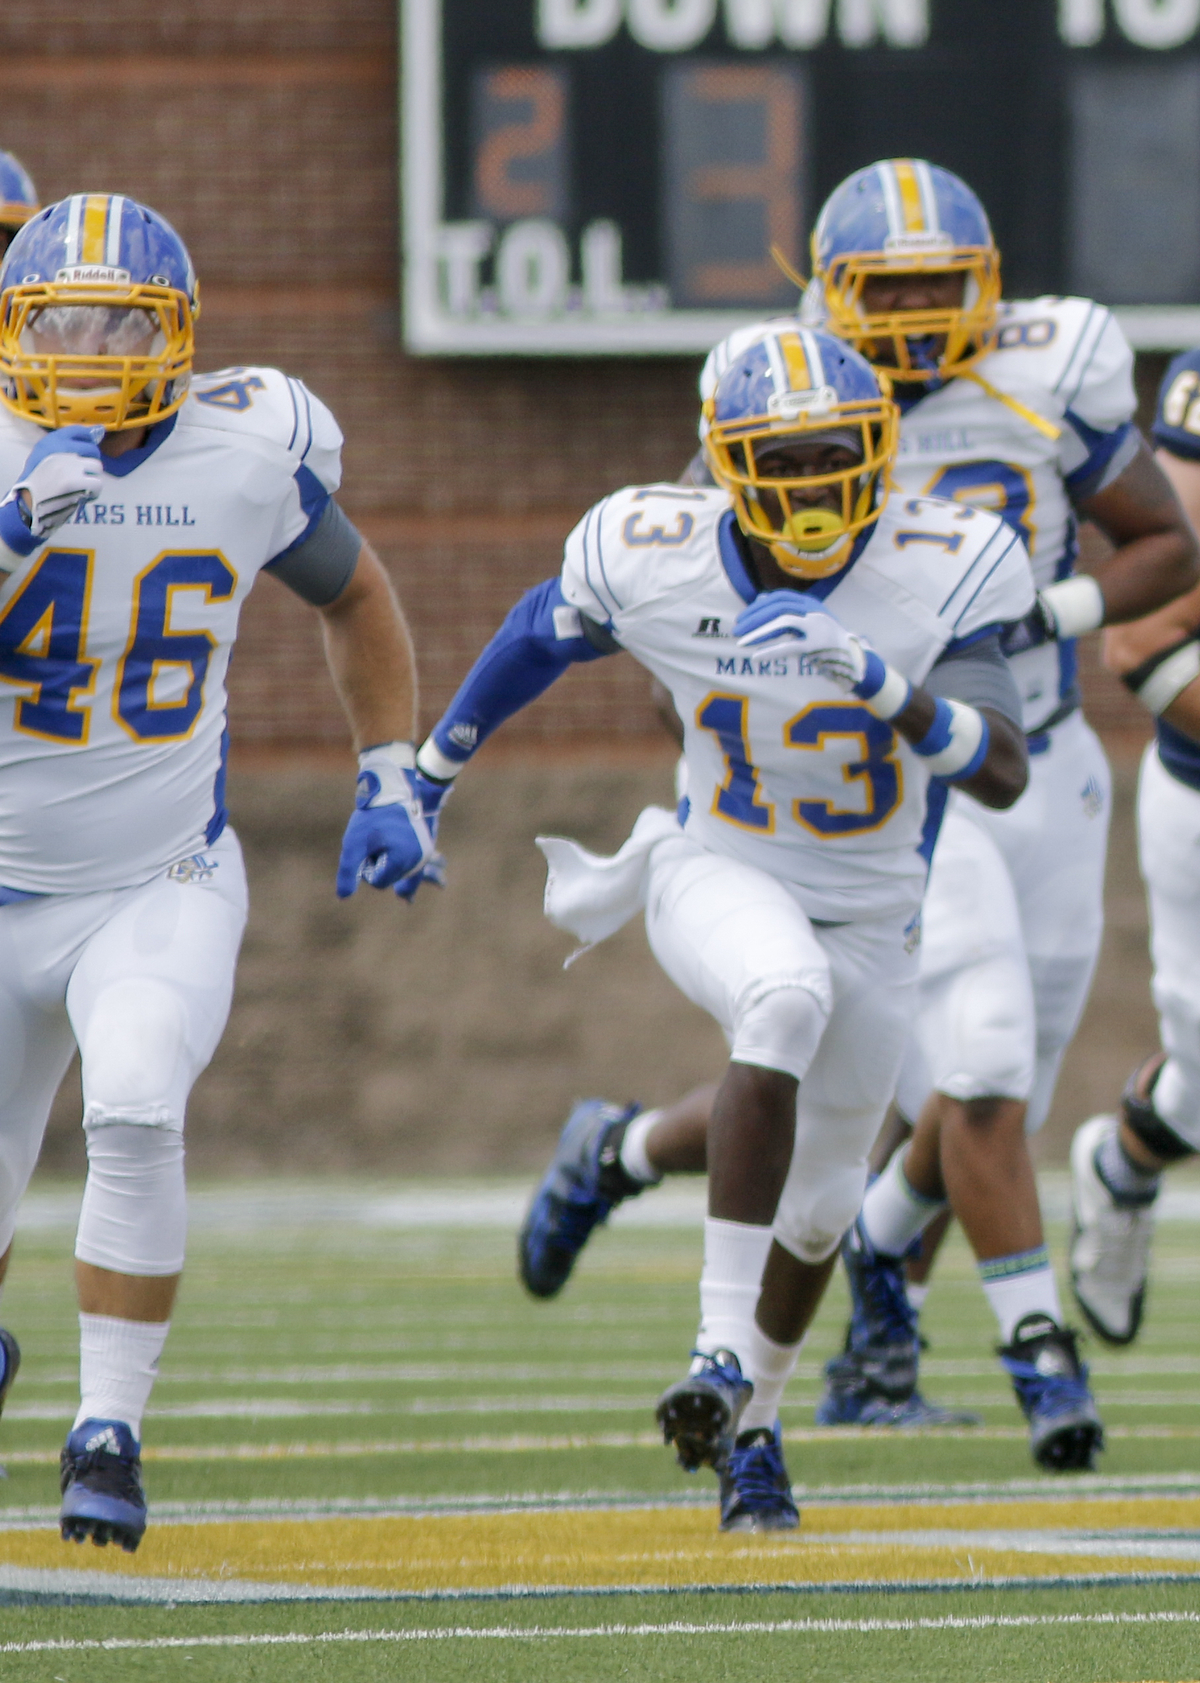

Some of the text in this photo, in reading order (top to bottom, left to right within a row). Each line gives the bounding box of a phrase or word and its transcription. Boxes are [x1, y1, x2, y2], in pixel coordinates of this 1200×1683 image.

[475, 66, 565, 217] 2
[690, 64, 801, 298] 3
[72, 269, 116, 281] Riddell
[66, 500, 196, 526] ARS HILL
[0, 546, 239, 747] 46
[715, 656, 790, 677] MARS
[694, 690, 904, 842] 13
